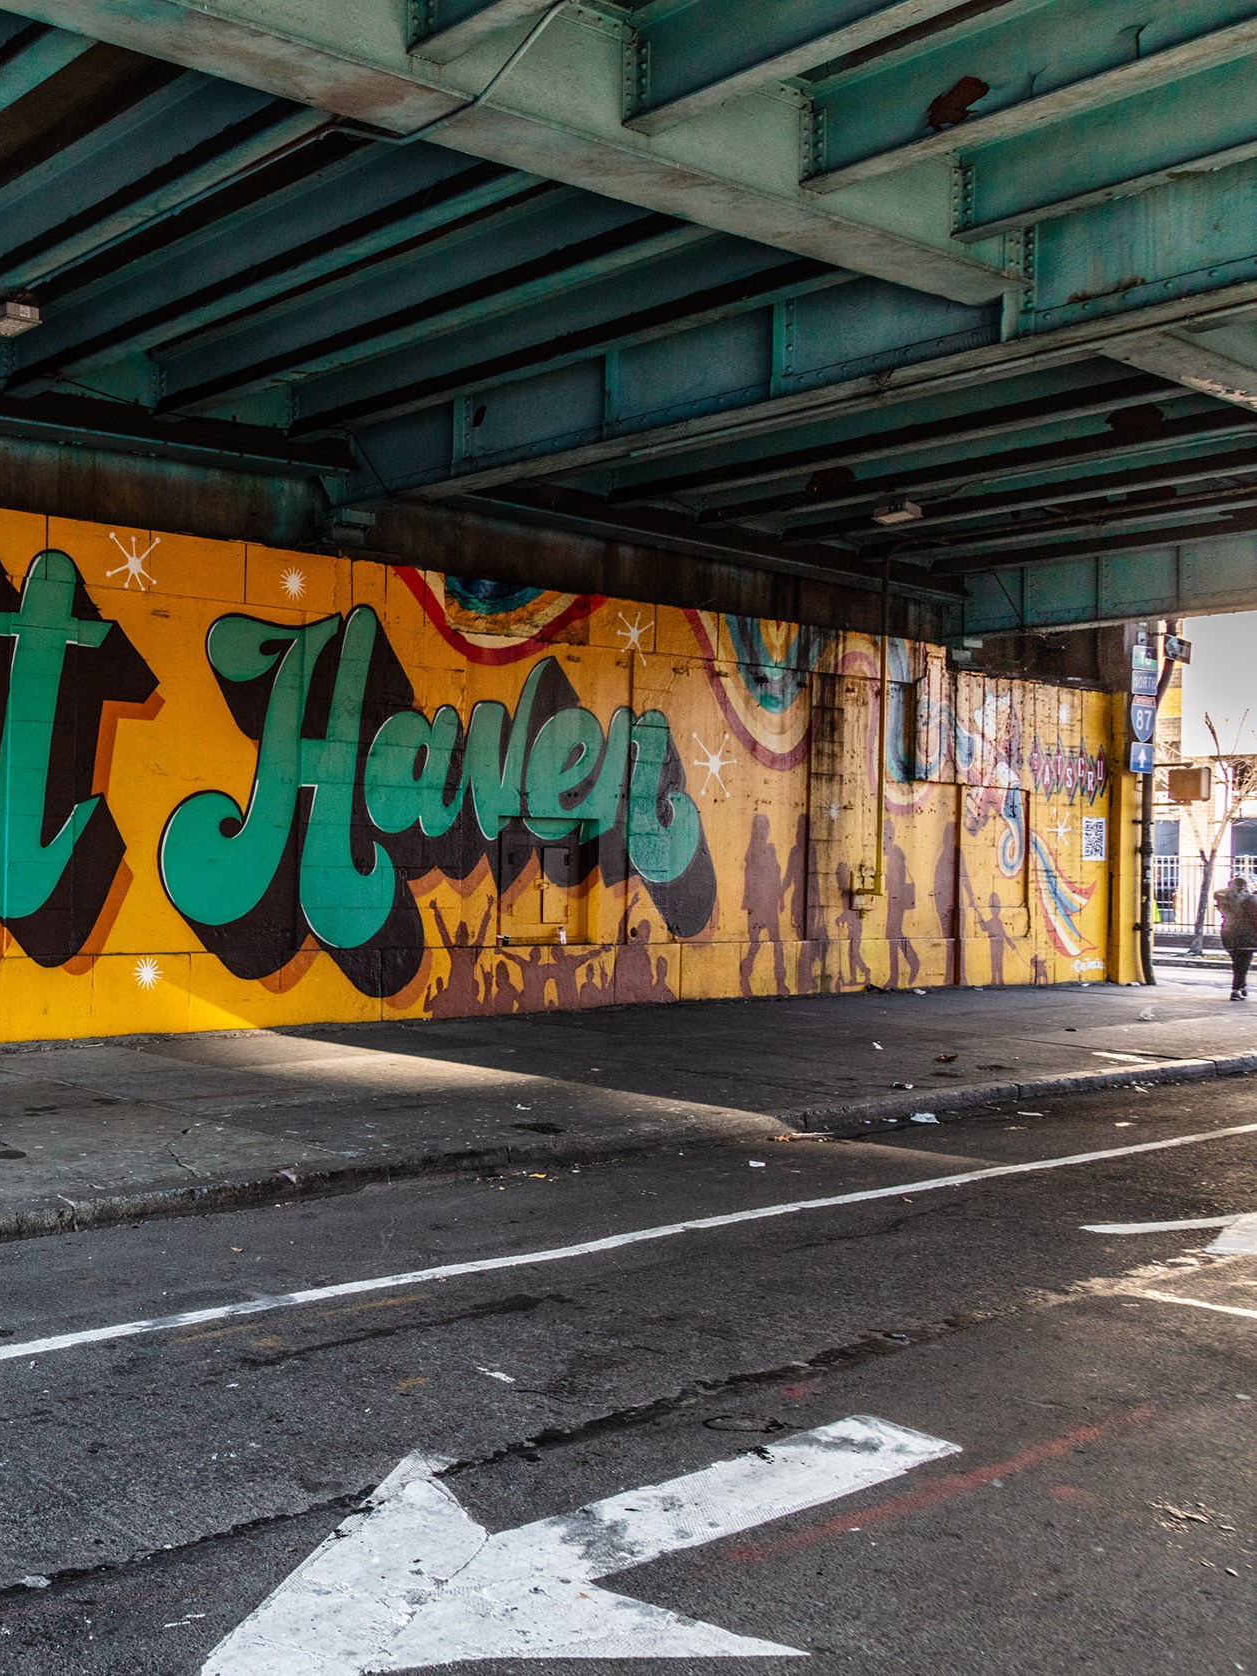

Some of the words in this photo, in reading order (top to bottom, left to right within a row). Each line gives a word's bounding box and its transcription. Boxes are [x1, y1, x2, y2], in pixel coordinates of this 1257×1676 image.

[1134, 675, 1156, 690] NORTH
[1136, 709, 1153, 731] 87
[158, 603, 701, 951] Haven
